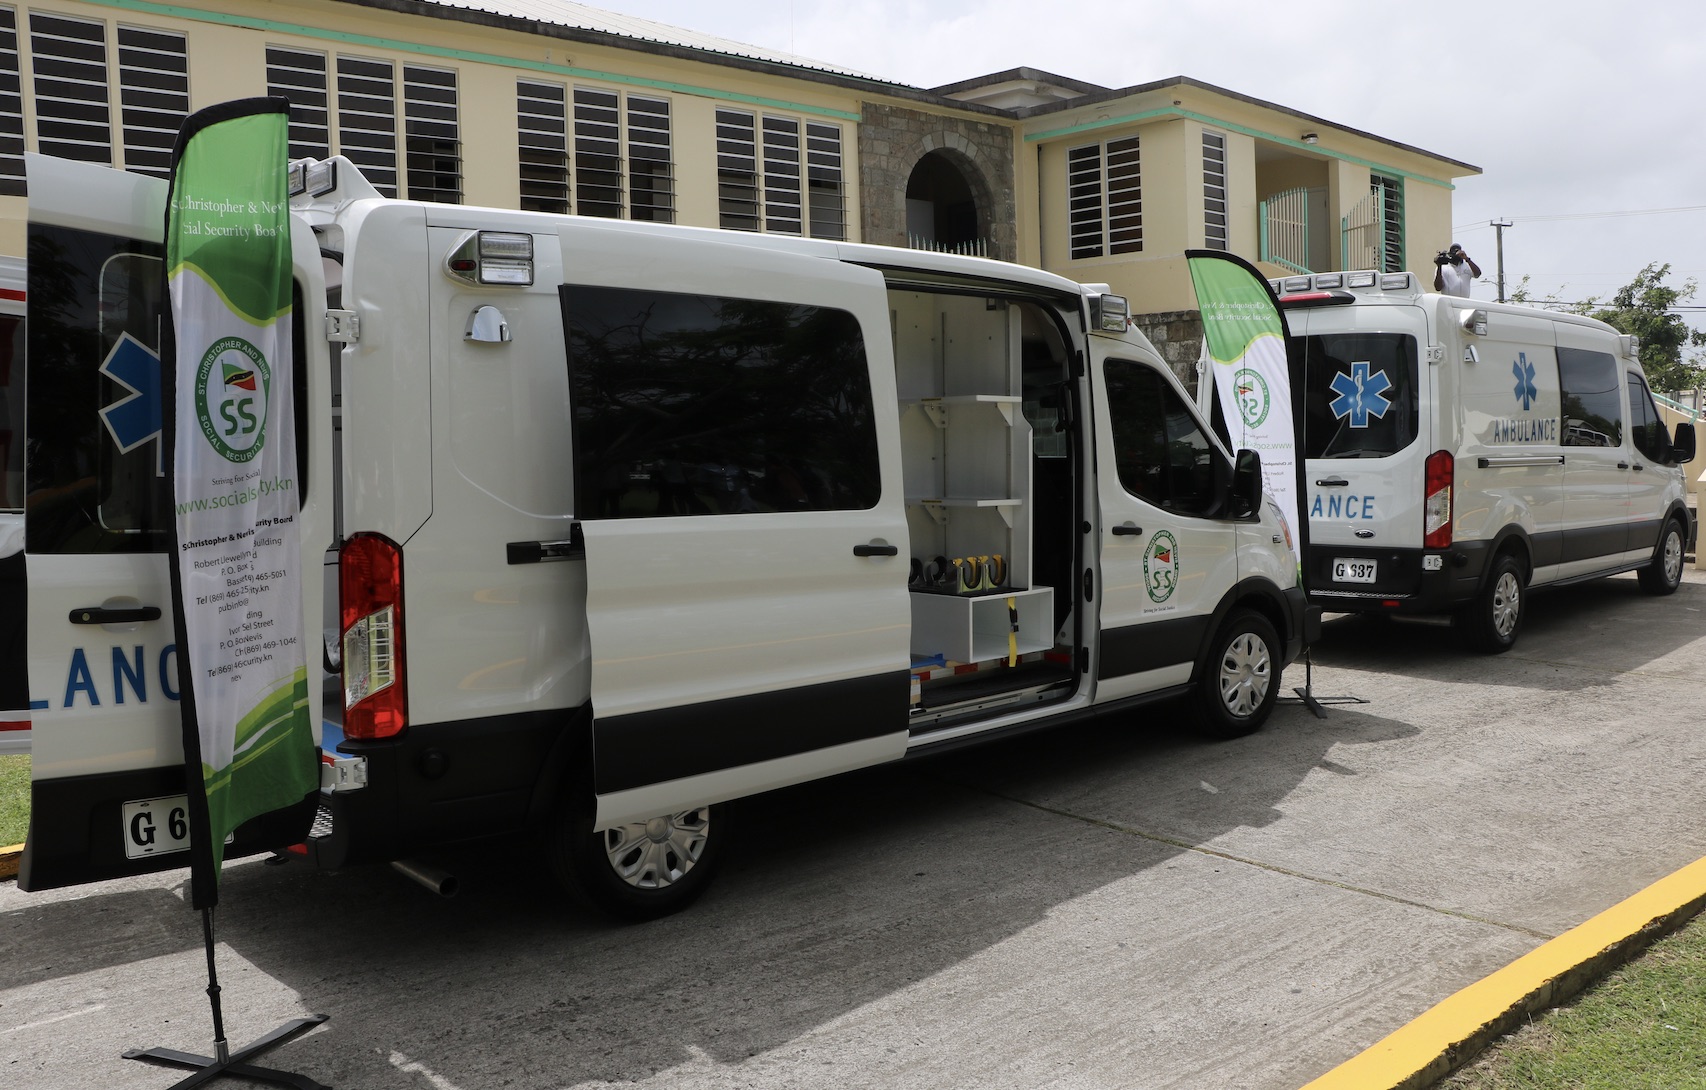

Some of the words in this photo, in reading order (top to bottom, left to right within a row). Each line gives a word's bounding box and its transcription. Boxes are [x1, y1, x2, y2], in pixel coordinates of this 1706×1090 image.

[248, 201, 258, 214] &
[205, 222, 250, 242] Security
[199, 340, 242, 380] CHRISTOPHER
[242, 344, 258, 360] AND
[200, 414, 221, 450] SOCIAL
[225, 440, 262, 461] SECURITY
[1494, 419, 1556, 443] AMBULANCE
[212, 478, 234, 486] Striving
[234, 475, 244, 483] for
[245, 469, 260, 481] Social
[1310, 494, 1375, 519] ANCE
[229, 533, 236, 541] &
[273, 515, 293, 525] Board
[194, 558, 220, 569] Robert
[1335, 563, 1345, 577] G
[1350, 564, 1374, 578] 637
[196, 595, 208, 606] Tel
[253, 619, 274, 630] Street
[29, 643, 181, 710] ANC
[130, 811, 157, 846] G
